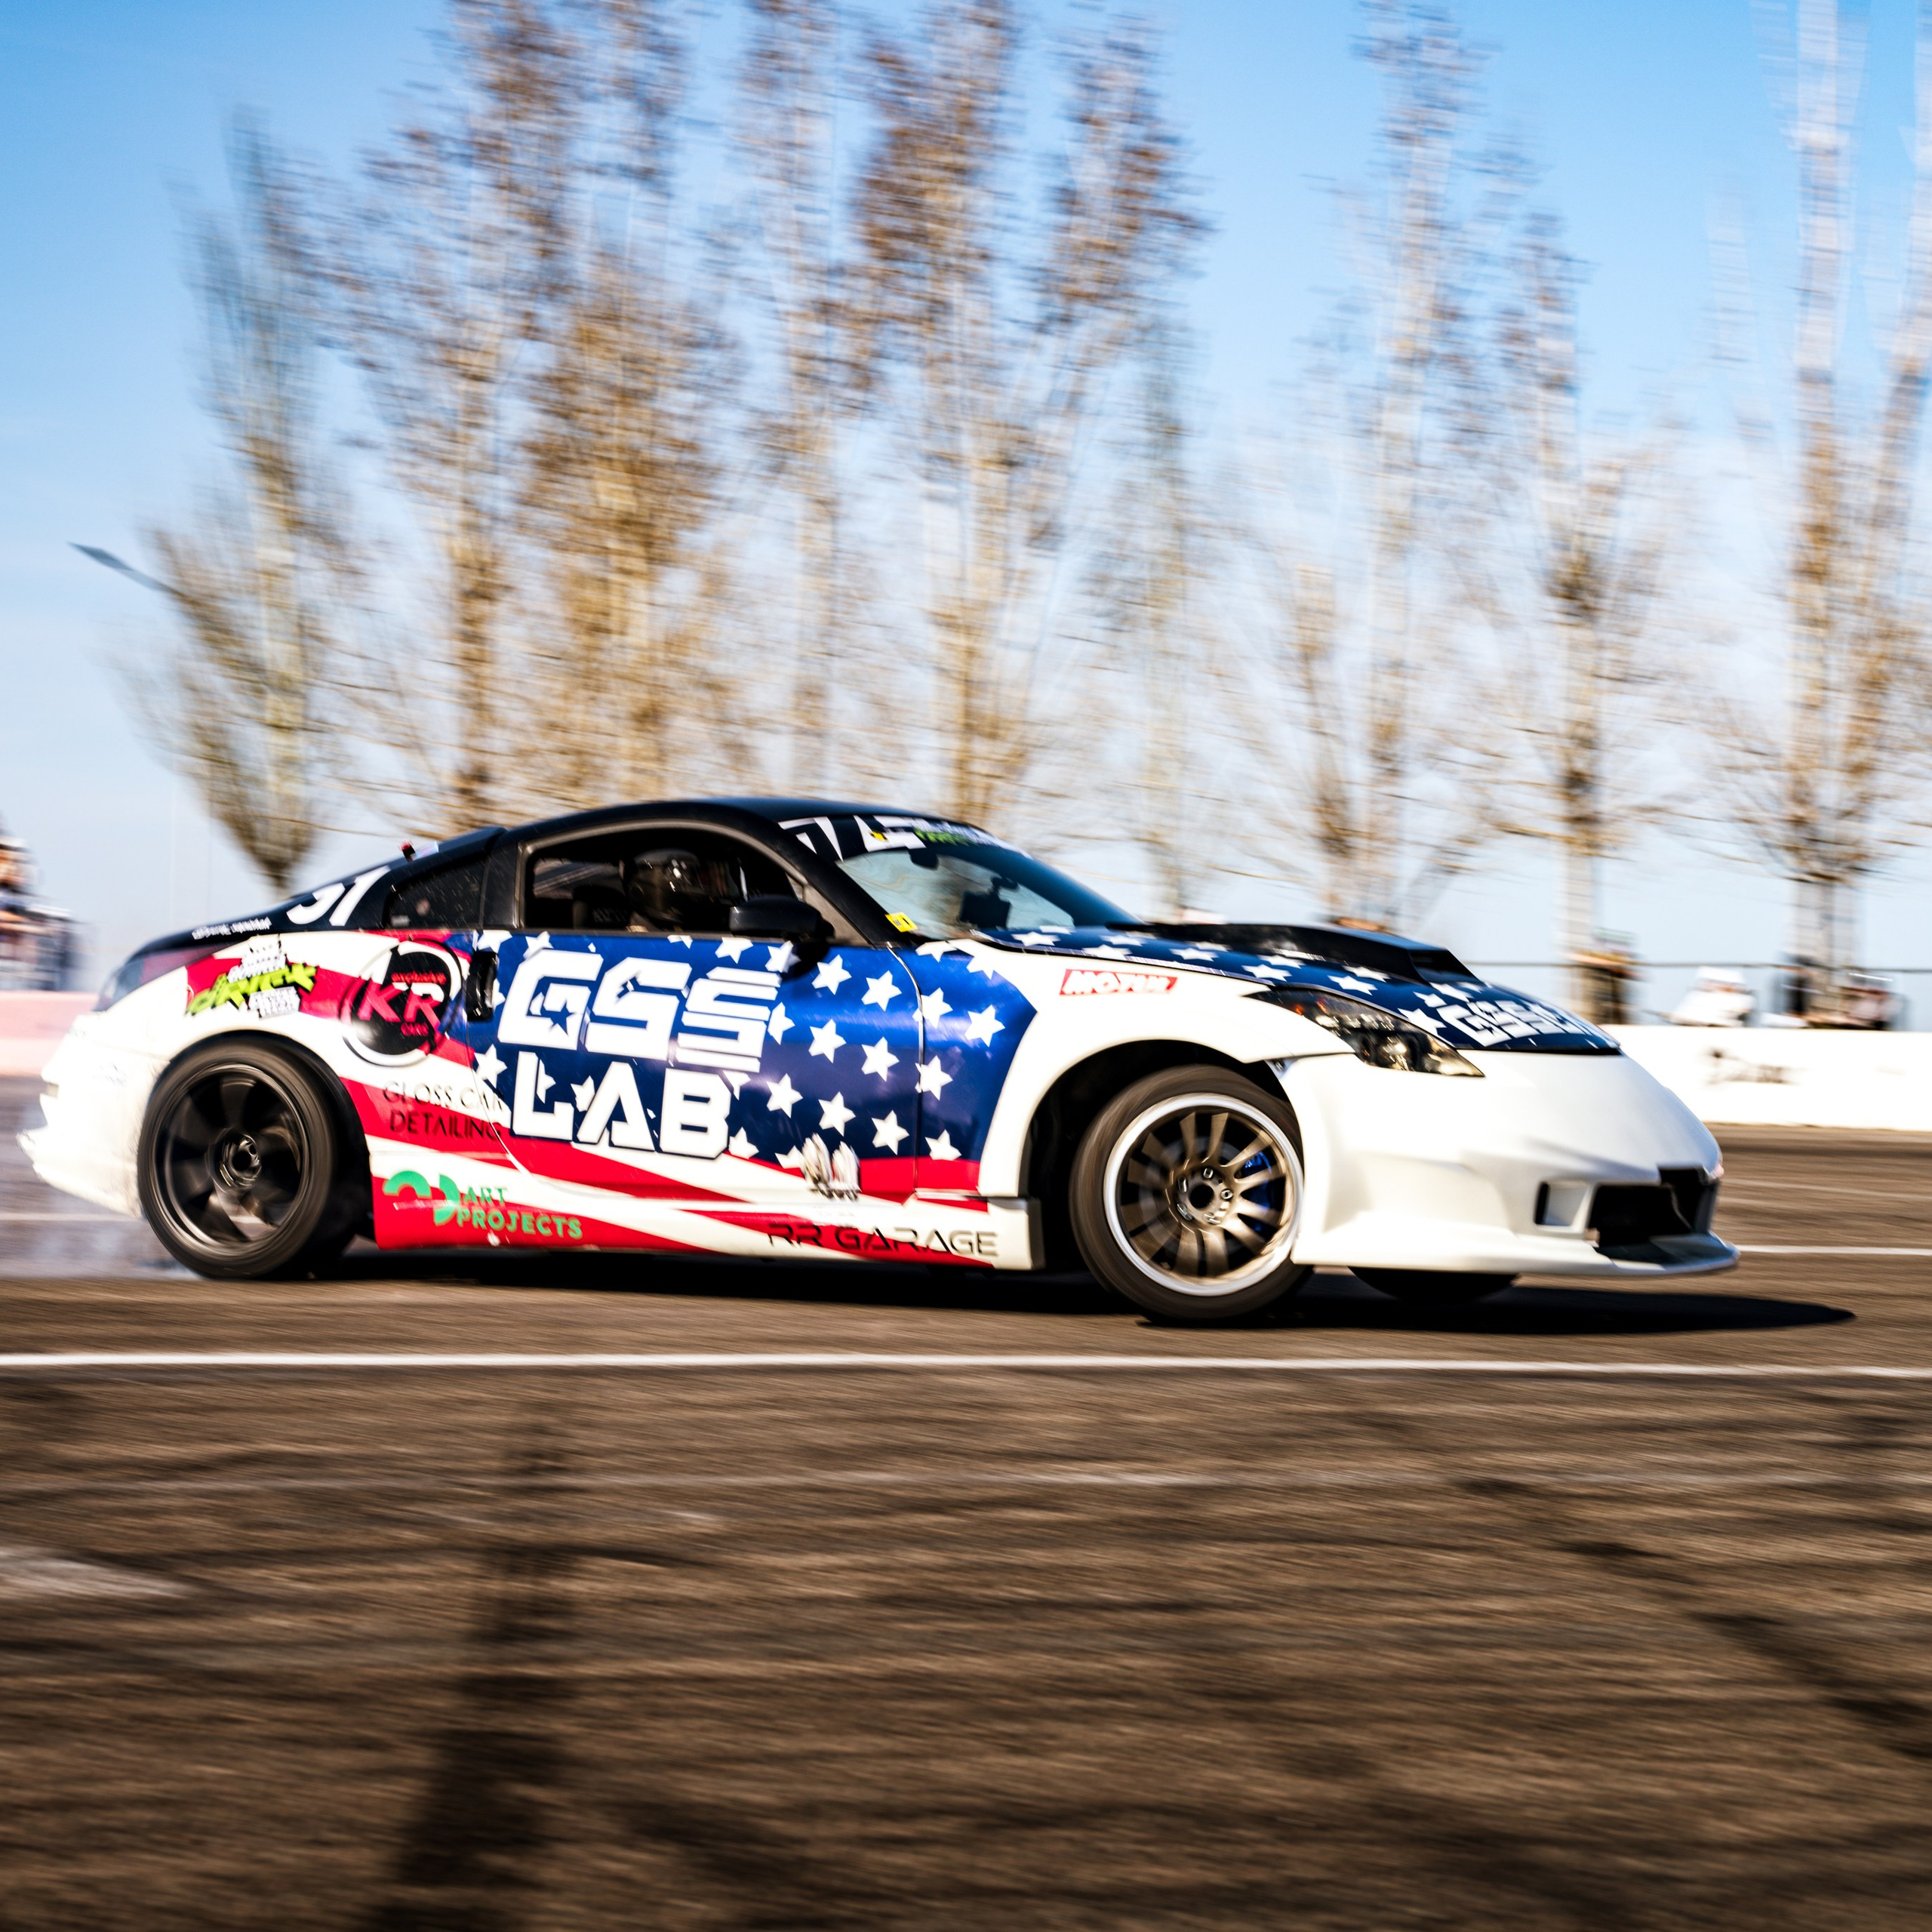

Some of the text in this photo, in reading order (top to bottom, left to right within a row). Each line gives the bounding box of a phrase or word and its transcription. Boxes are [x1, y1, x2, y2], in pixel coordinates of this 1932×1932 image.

[357, 977, 445, 1030] KR
[383, 1081, 454, 1109] GLOSS
[512, 1051, 731, 1159] LAB
[389, 1110, 503, 1140] DETAILING
[463, 1186, 508, 1205] ART
[456, 1208, 583, 1240] PROJECTS
[767, 1223, 999, 1257] RR GARAGE
